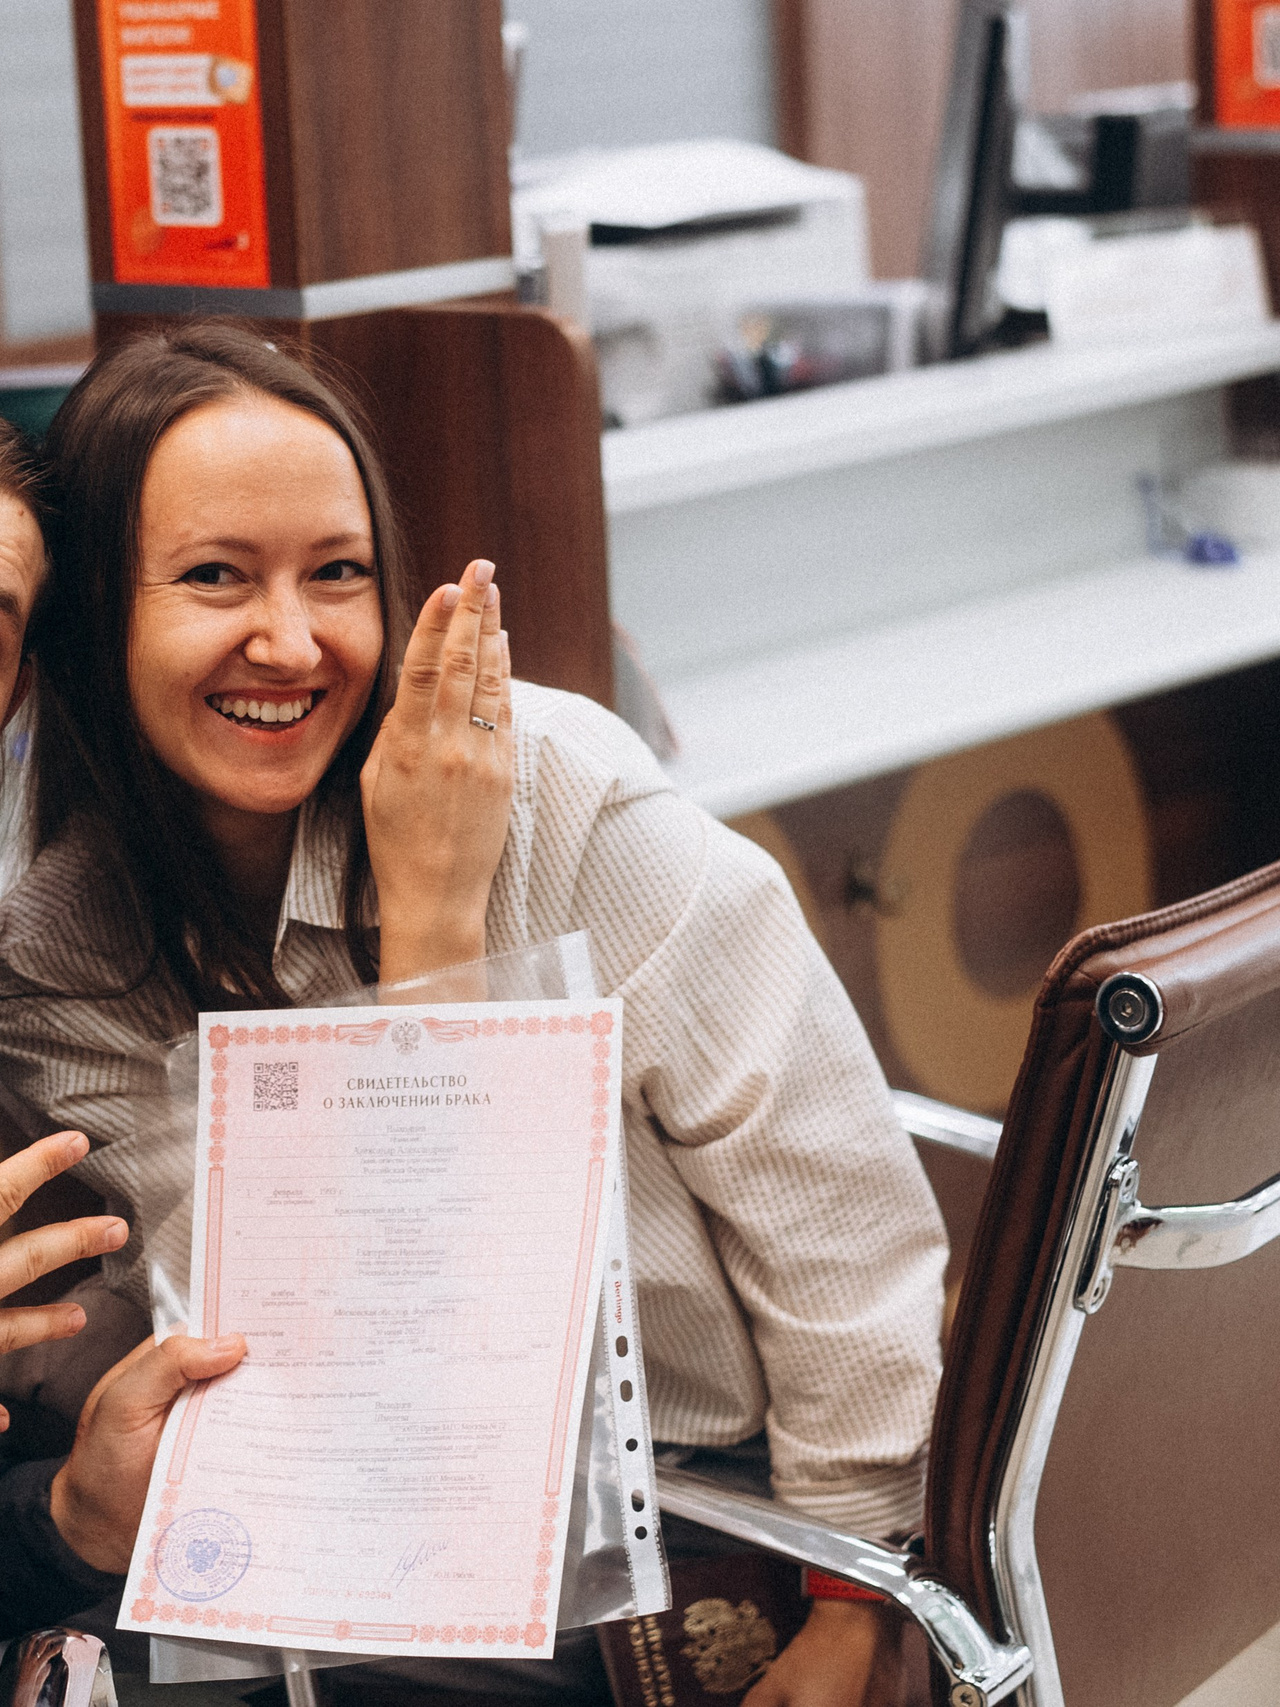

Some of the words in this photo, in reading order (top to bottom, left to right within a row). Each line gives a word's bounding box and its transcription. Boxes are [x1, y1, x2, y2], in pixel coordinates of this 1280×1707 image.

[347, 1075, 467, 1091] СВИДЕТЕЛЬСТВО
[323, 1096, 334, 1110] О
[338, 1094, 442, 1109] ЗАКЛЮЧЕНИИ
[445, 1092, 491, 1107] БРАКА
[614, 1280, 622, 1324] Berlingo
[643, 1615, 675, 1706] ФЕДЕРАЦИ
